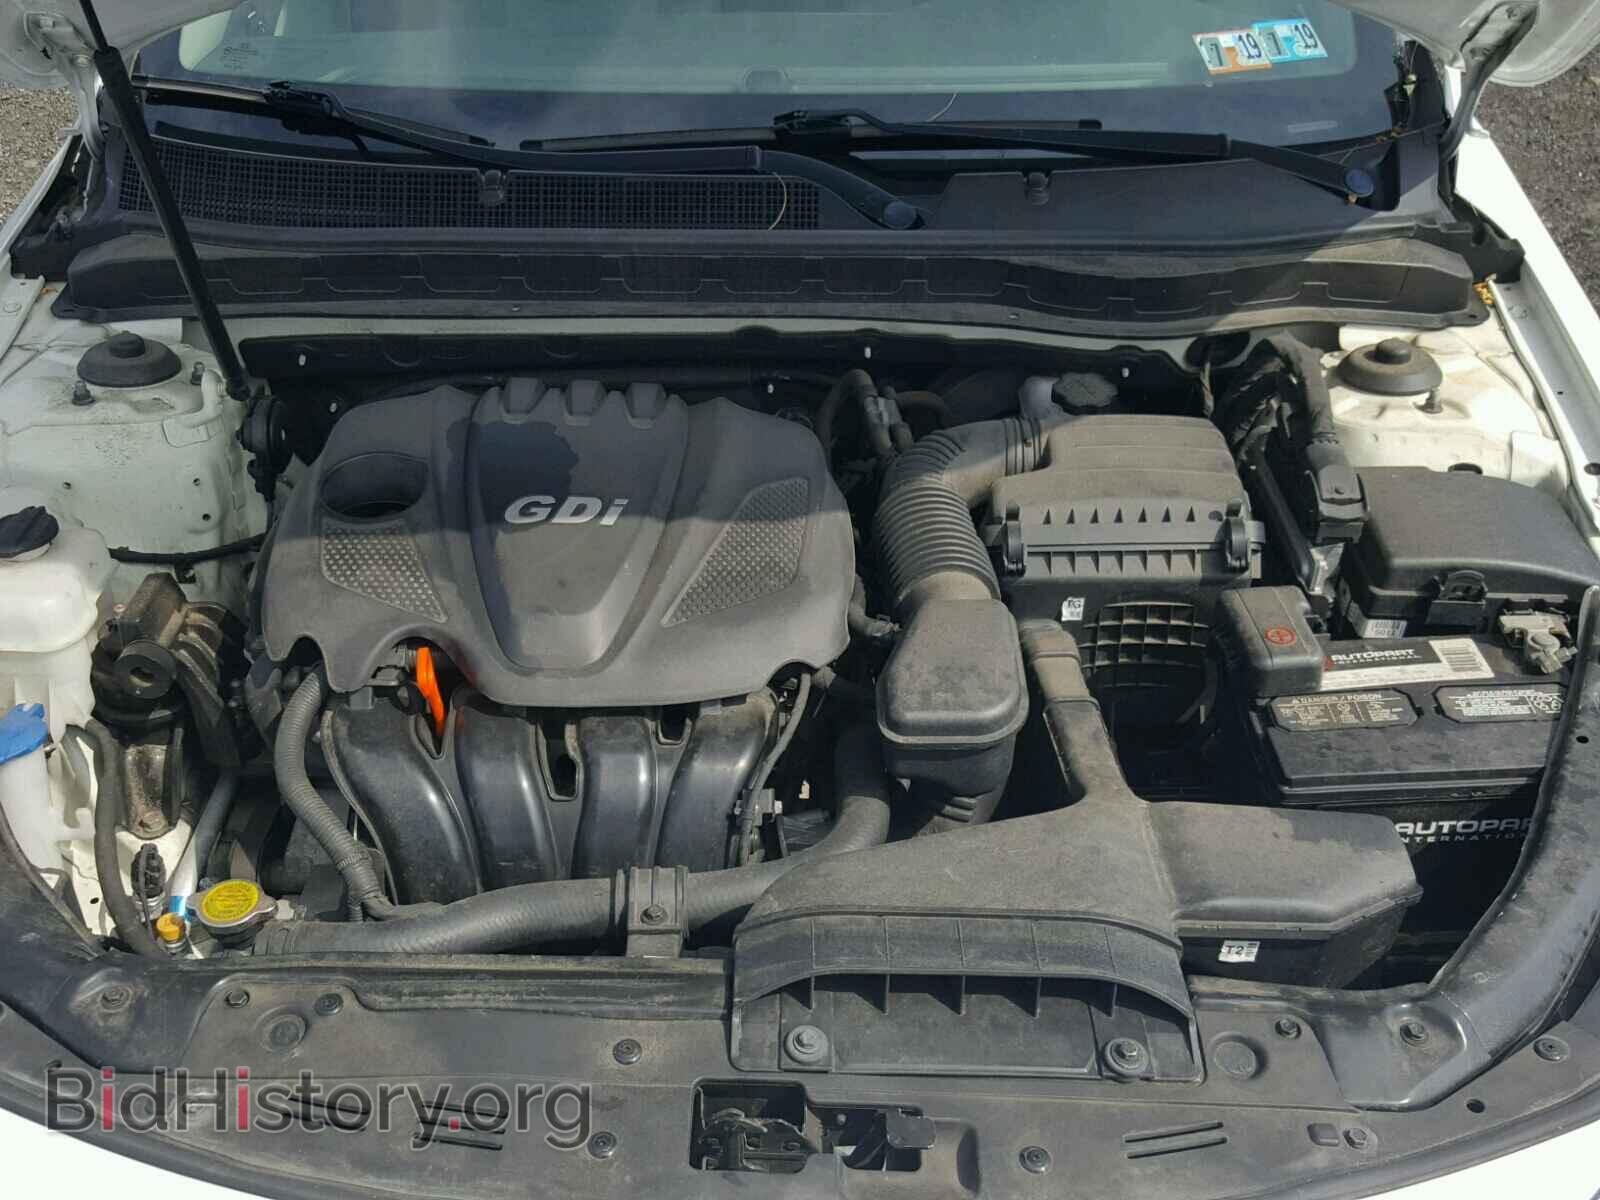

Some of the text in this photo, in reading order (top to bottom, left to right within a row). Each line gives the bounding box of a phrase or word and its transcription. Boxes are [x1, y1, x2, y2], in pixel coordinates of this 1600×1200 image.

[1238, 32, 1262, 58] 19
[1294, 23, 1318, 48] 19
[504, 495, 629, 526] GDi
[1331, 648, 1415, 661] AUTOPART
[1225, 945, 1245, 956] T2
